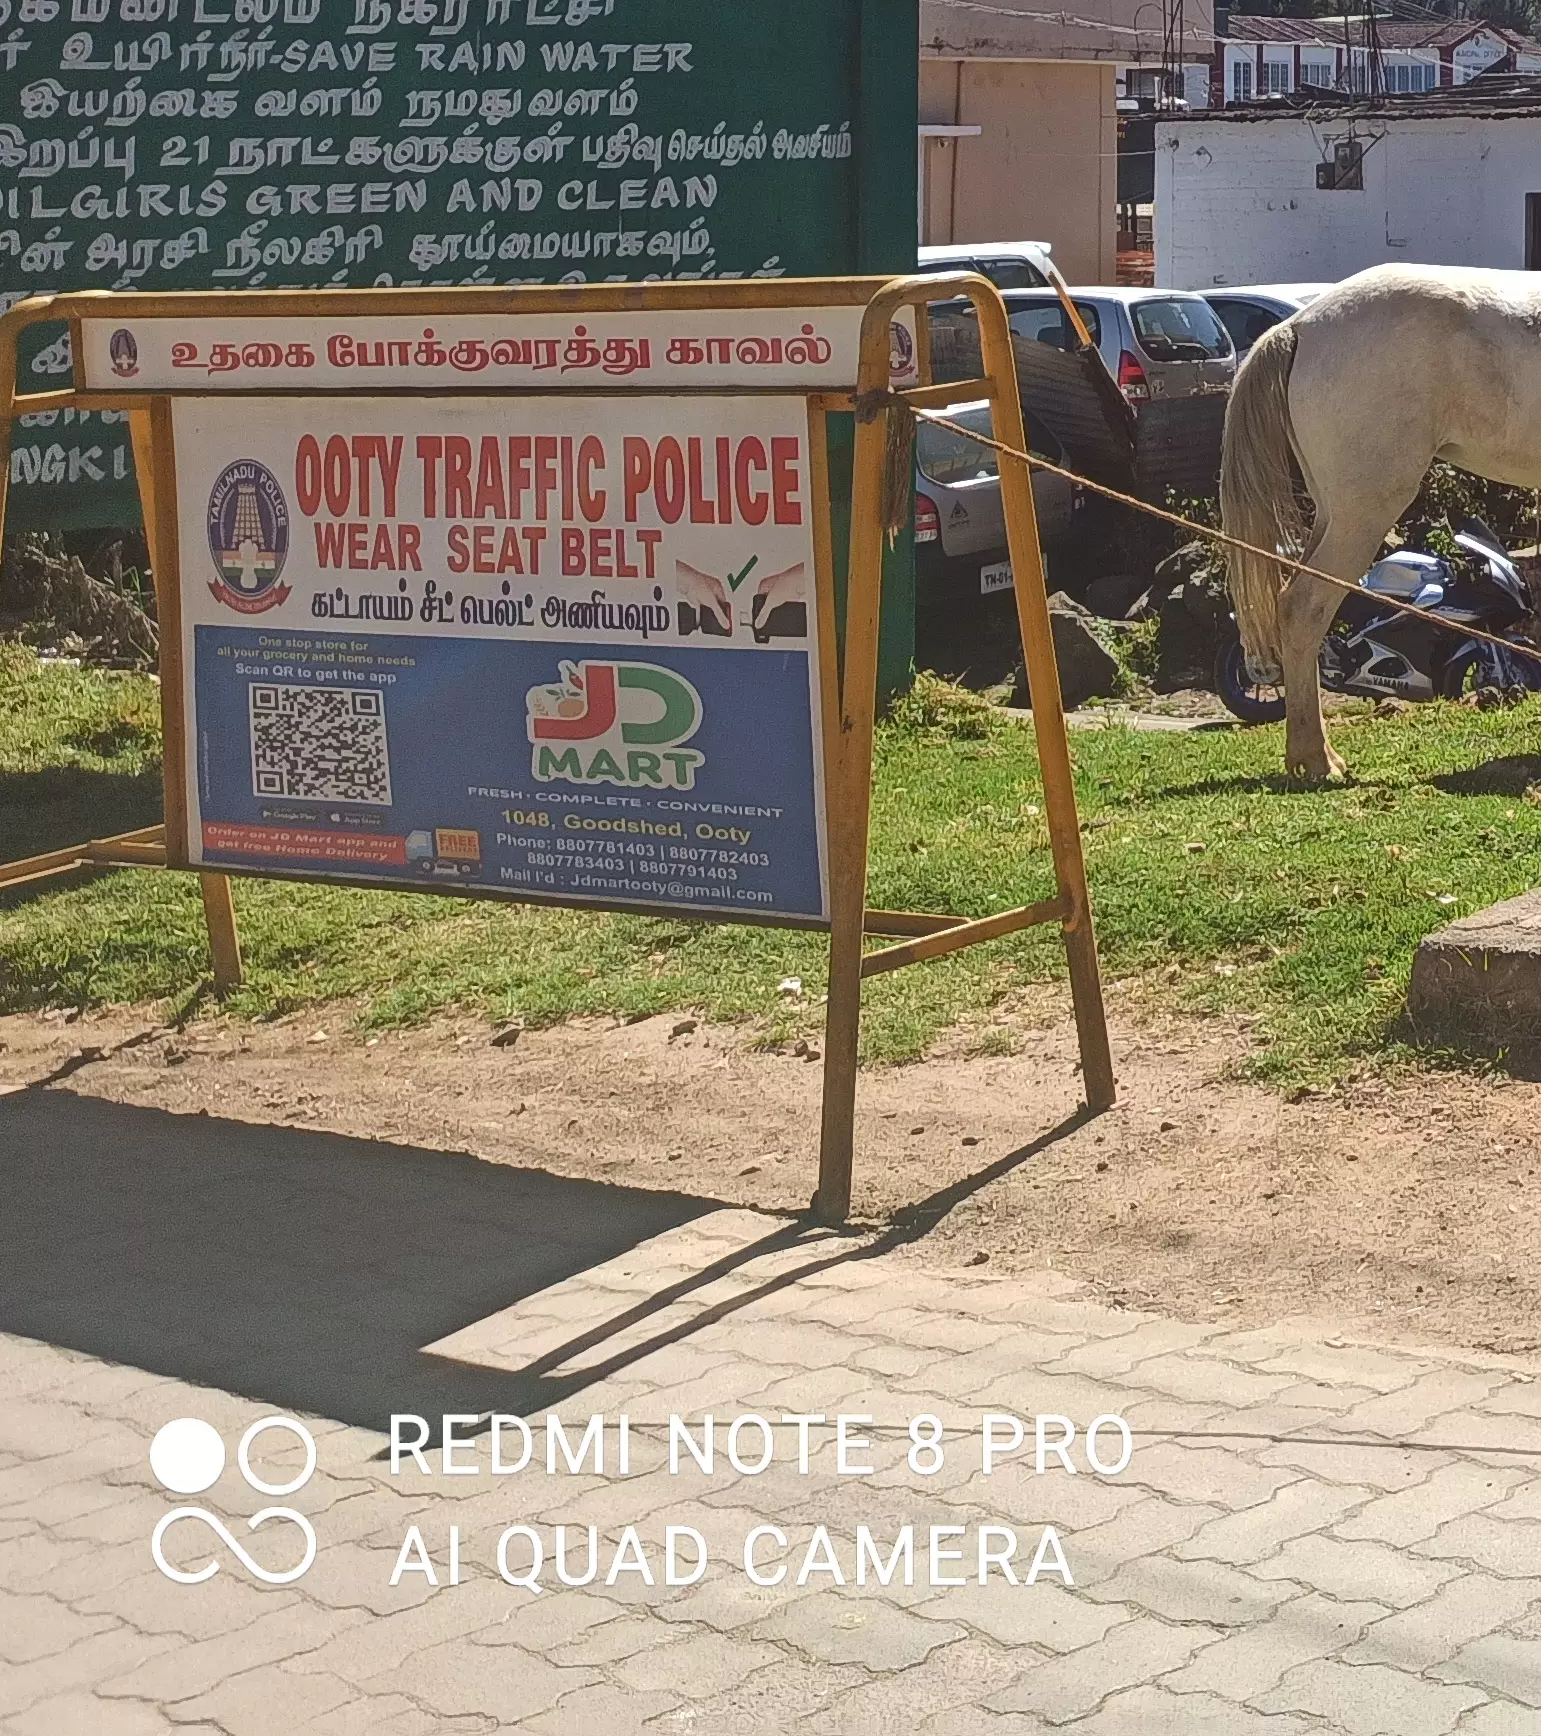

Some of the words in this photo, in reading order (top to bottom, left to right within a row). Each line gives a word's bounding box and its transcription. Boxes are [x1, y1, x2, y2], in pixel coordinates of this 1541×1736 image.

[415, 40, 526, 73] RAIN
[540, 42, 694, 72] WATER
[20, 77, 240, 127] இயற்கை
[254, 76, 382, 118] வளம்
[527, 77, 639, 118] வளம்
[160, 136, 211, 167] 21
[582, 122, 663, 175] பதிவு
[668, 119, 767, 167] செய்தல்
[0, 180, 229, 220] ILGIRIS
[246, 178, 428, 218] GREEN
[446, 176, 543, 213] AND
[557, 174, 718, 212] CLEAN
[171, 340, 315, 377] உதகை
[327, 324, 651, 376] போக்குவரத்து
[666, 323, 832, 366] காவல்
[296, 433, 405, 518] OOTY
[416, 434, 606, 523] TRAFFIC
[623, 436, 803, 526] POLICE
[314, 523, 422, 572] WEAR
[447, 524, 547, 576] SEAT
[560, 527, 662, 579] BELT
[311, 578, 413, 622] கட்டாயம்
[420, 580, 456, 623] சீட்
[460, 582, 535, 628] பெல்ட்
[540, 587, 670, 632] அணியவும்
[217, 646, 231, 658] all
[233, 648, 260, 661] your
[262, 649, 308, 663] grocery
[312, 651, 335, 663] and
[338, 653, 374, 665] home
[377, 655, 416, 667] needs
[258, 635, 283, 648] One
[286, 638, 312, 652] stop
[315, 639, 347, 651] store
[350, 640, 369, 652] for
[235, 662, 269, 677] Scan
[272, 664, 294, 678] QR
[297, 666, 312, 679] to
[315, 668, 338, 682] get
[342, 669, 366, 682] the
[369, 671, 398, 686] app
[533, 664, 696, 745] JD
[538, 746, 698, 786] MART
[467, 786, 523, 800] FRESH
[535, 792, 642, 808] COMPLETE
[656, 800, 784, 818] CONVENIENT
[207, 825, 245, 838] Order
[295, 832, 332, 844] Mart
[370, 839, 397, 849] and
[501, 809, 556, 831] 1048,
[563, 814, 688, 839] Goodshed,
[695, 823, 752, 846] Ooty
[275, 844, 320, 854] Home
[325, 847, 389, 862] Delivery
[527, 852, 625, 872] 8807783403
[639, 861, 738, 881] 8807791403
[556, 838, 655, 857] 8807781403
[669, 846, 770, 866] 8807782403
[500, 866, 533, 884] Mail
[570, 874, 774, 903] Jdmartooty@gmail.com
